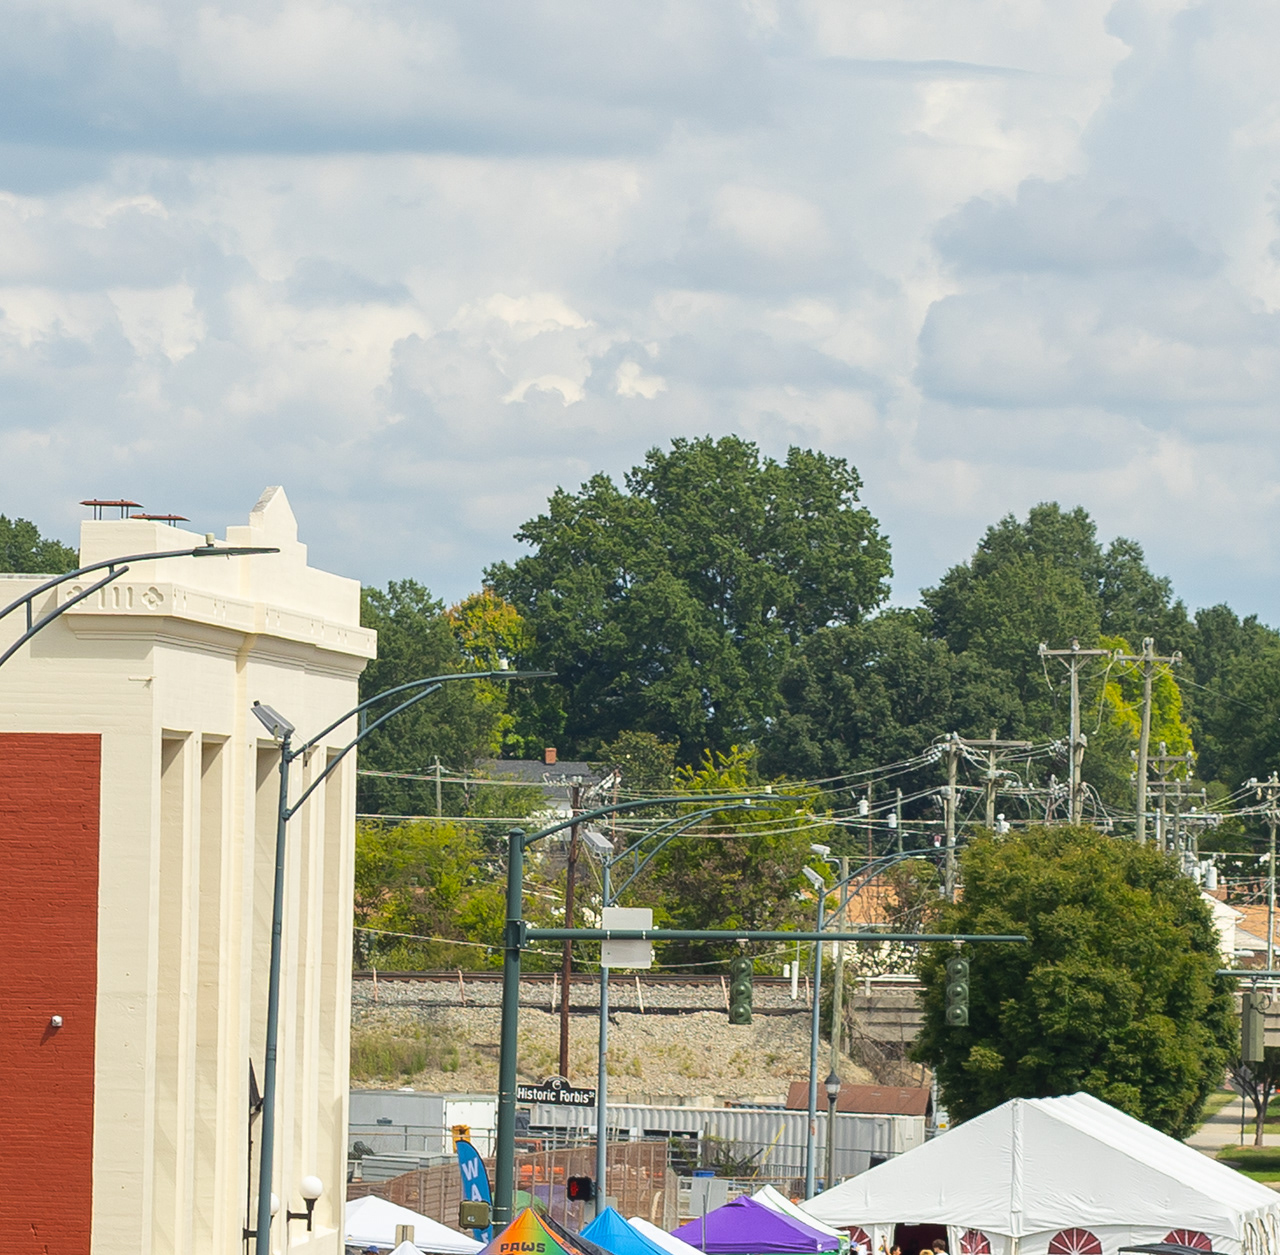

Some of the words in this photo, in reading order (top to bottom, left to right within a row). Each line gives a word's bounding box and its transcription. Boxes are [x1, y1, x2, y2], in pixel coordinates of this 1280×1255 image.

[517, 1087, 557, 1101] Historic
[560, 1090, 589, 1103] Forbis
[500, 1242, 546, 1253] PAWS
